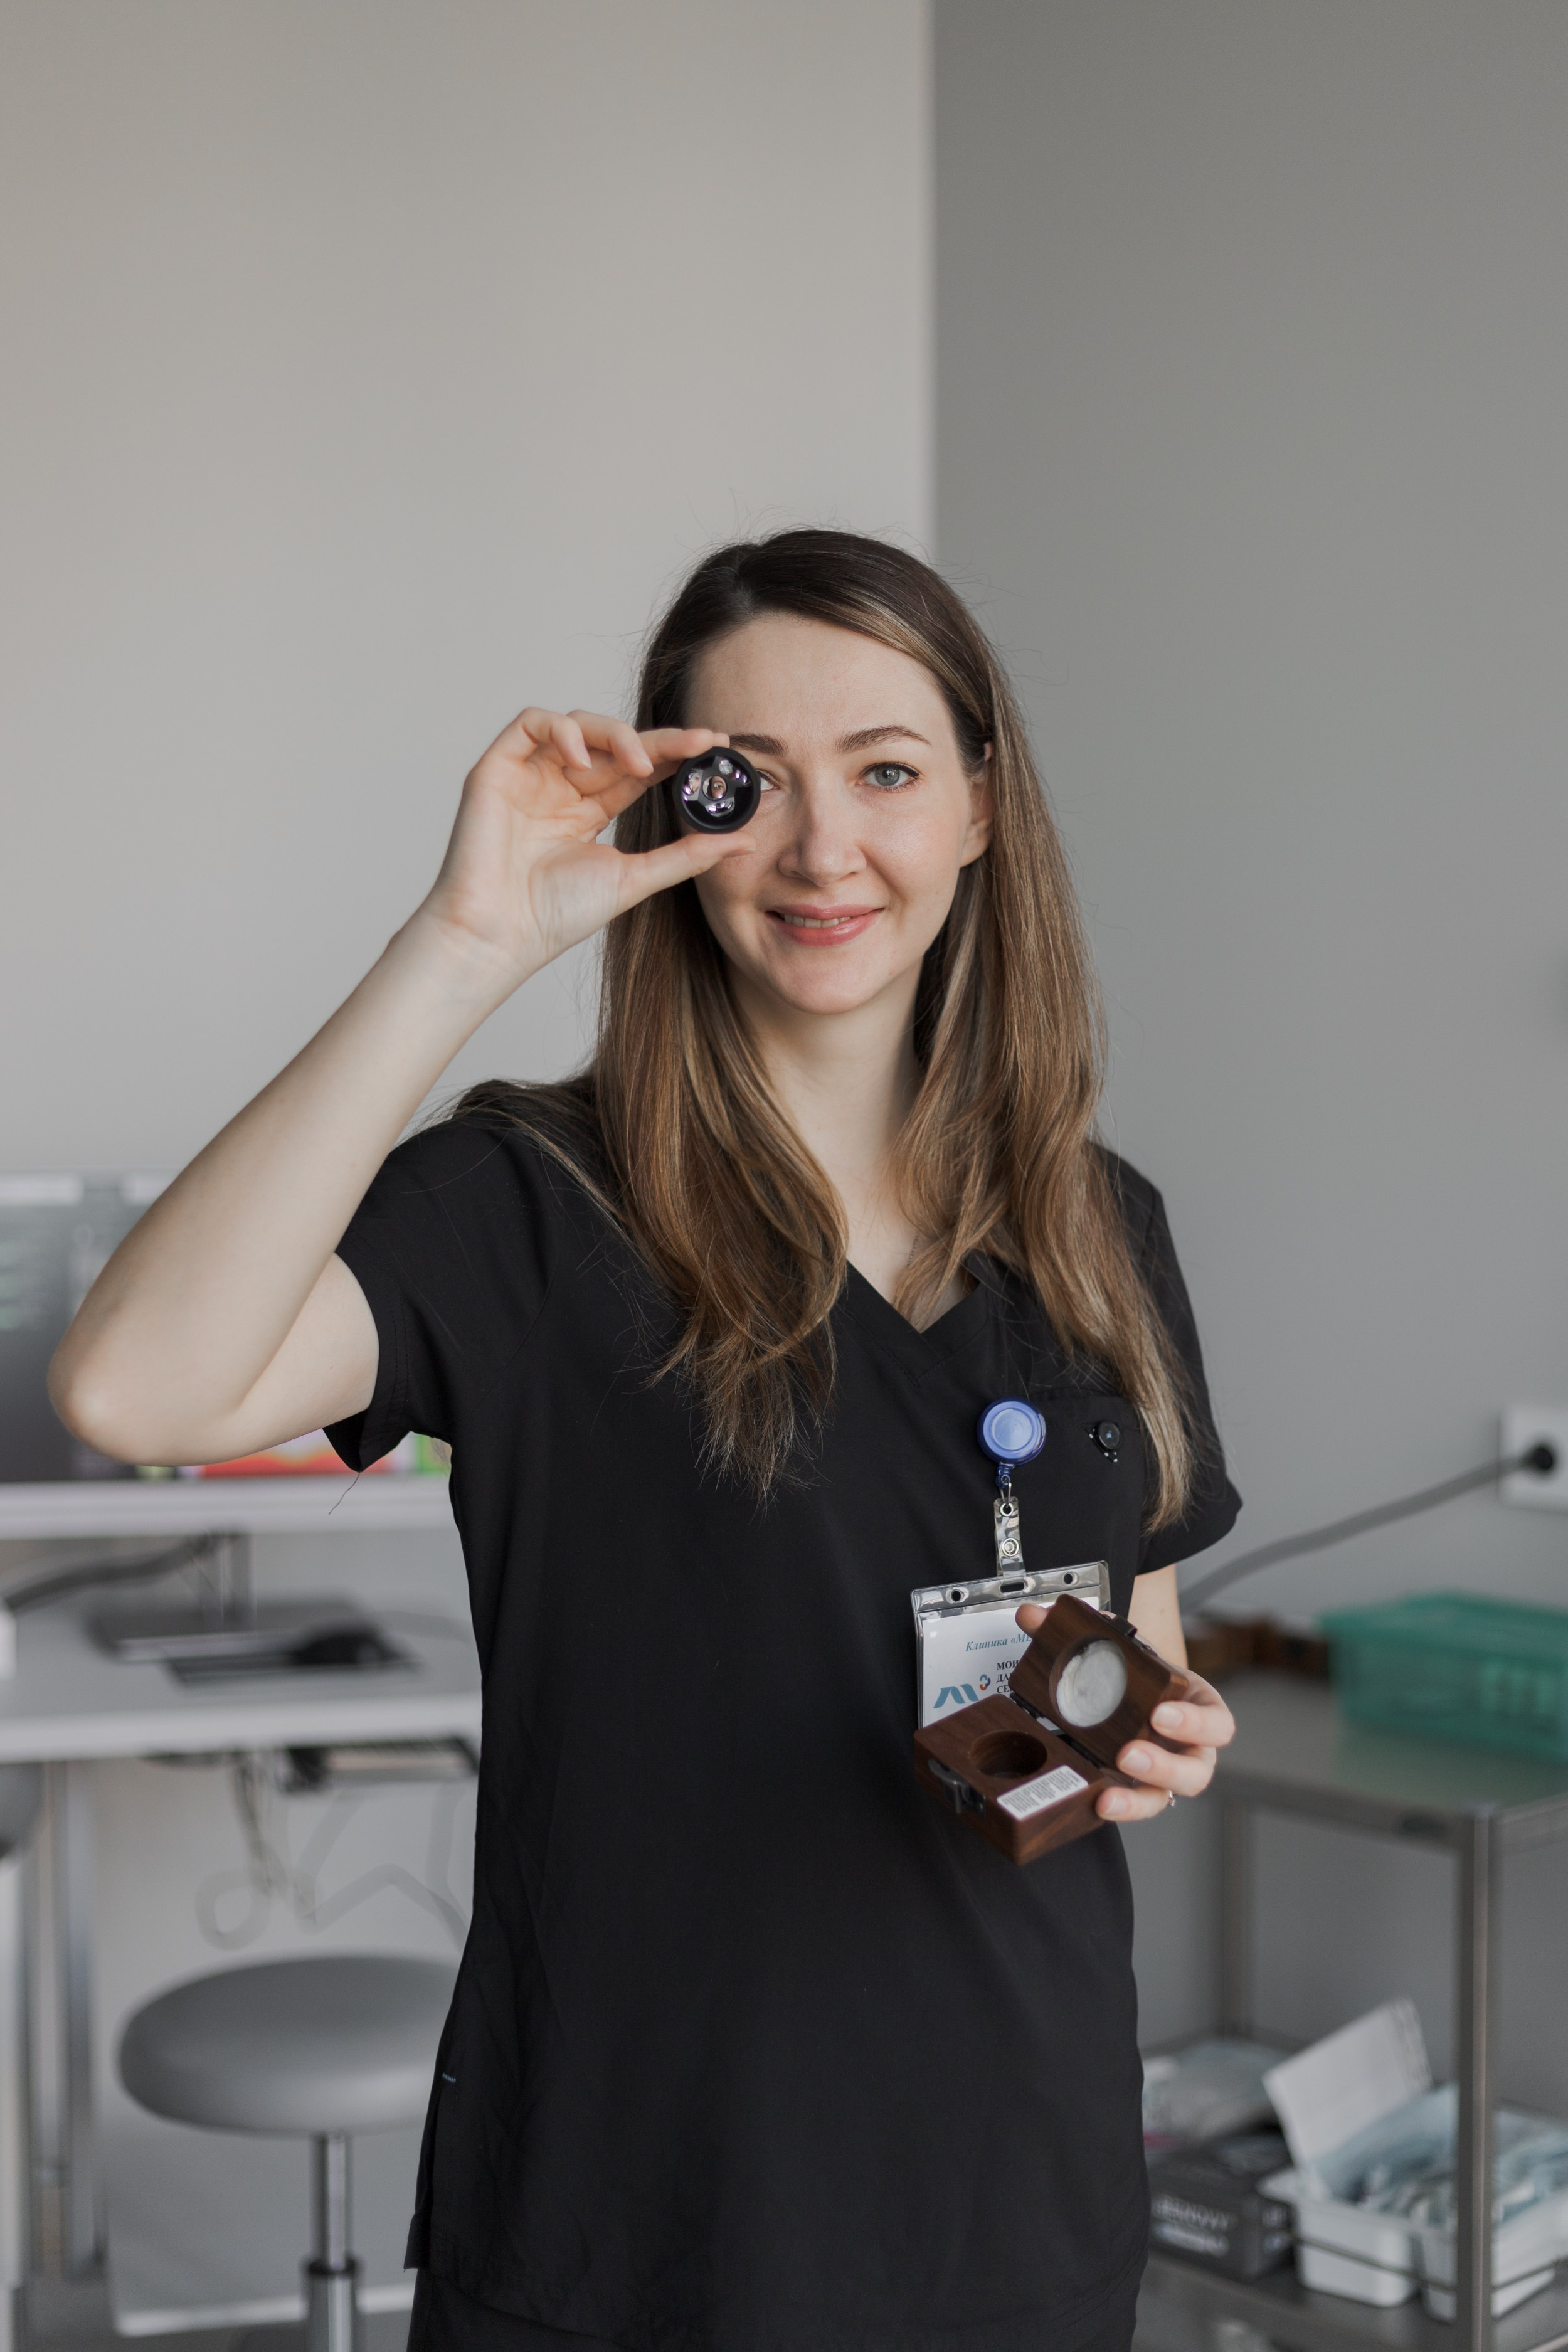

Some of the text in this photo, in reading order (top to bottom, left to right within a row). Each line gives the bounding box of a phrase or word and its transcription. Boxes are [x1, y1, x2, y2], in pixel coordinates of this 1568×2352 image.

[965, 1638, 1008, 1651] Клиника
[996, 1672, 1013, 1683] ДА
[997, 1685, 1013, 1693] СЕ
